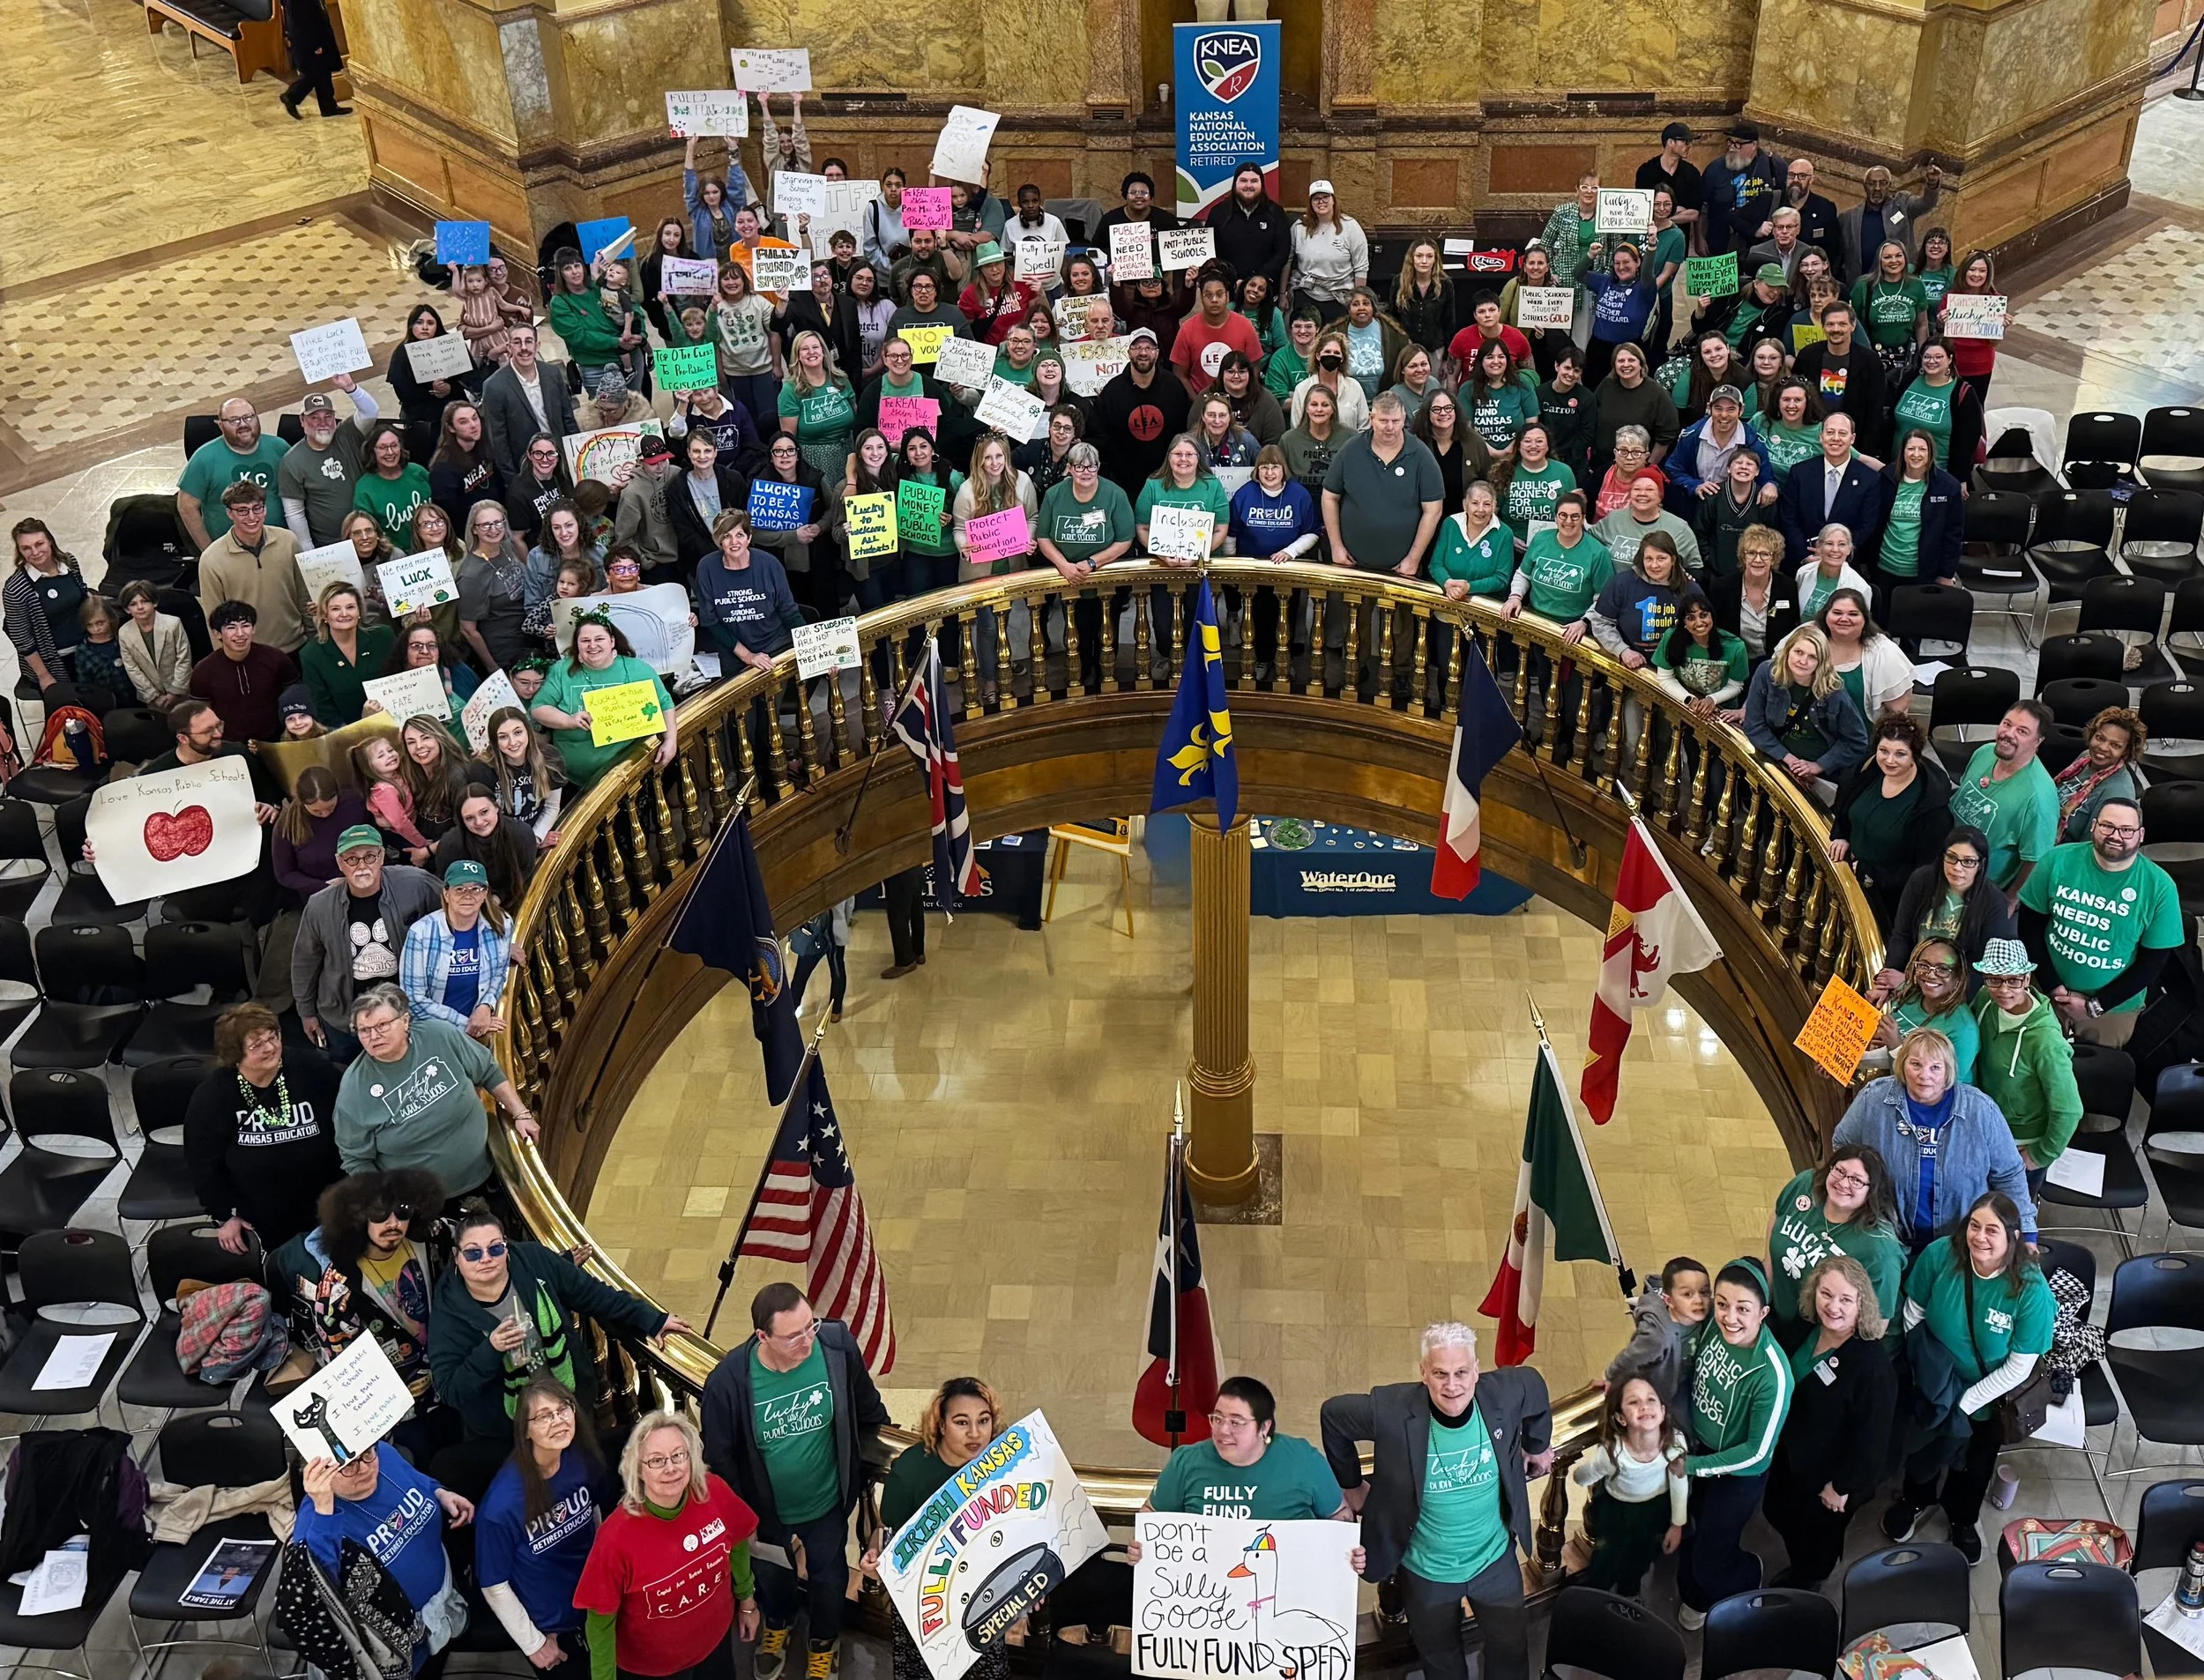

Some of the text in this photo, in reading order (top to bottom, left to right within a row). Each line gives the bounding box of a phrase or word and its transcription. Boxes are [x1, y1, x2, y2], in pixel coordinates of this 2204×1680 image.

[1201, 39, 1255, 58] KNEA
[1189, 111, 1234, 122] KANSAS
[1189, 122, 1247, 132] NATIONAL
[1189, 132, 1255, 142] EDUCATION
[1189, 143, 1264, 152] ASSOCIATION
[1190, 157, 1236, 167] RETIRED
[1113, 225, 1144, 236] PUBLIC
[1116, 244, 1143, 255] NEED
[1164, 236, 1208, 249] ANTI-PUBLIC
[756, 249, 799, 260] FULLY
[1114, 252, 1150, 263] MENTAL
[1171, 247, 1206, 259] SCHOOLS
[756, 261, 794, 273] FUND
[1024, 256, 1054, 274] Sped!
[1121, 262, 1145, 271] HEALTH
[1688, 259, 1714, 271] PUBLIC
[1715, 266, 1735, 279] EVERY
[1116, 269, 1151, 279] SERVICES
[1549, 313, 1568, 323] GOLD
[912, 331, 936, 343] NO
[1096, 362, 1122, 376] NOT
[1820, 375, 1843, 396] KC
[895, 398, 917, 409] REAL
[1474, 416, 1512, 425] KANSAS
[463, 464, 488, 490] NEA
[756, 480, 800, 499] LUCKY
[1509, 480, 1549, 490] PUBLIC
[751, 494, 798, 509] TO BE A
[904, 486, 940, 502] PUBLIC
[1509, 489, 1547, 499] MONEY
[853, 502, 884, 518] Lucky
[901, 498, 938, 515] MONEY
[1509, 498, 1530, 507] FOR
[751, 507, 800, 520] KANSAS
[909, 510, 925, 522] FOR
[1248, 505, 1292, 520] PROUD
[1509, 505, 1551, 516] PUBLIC
[900, 517, 935, 532] PUBLIC
[1155, 509, 1211, 532] Inclusion
[899, 529, 937, 544] SCHOOLS
[970, 529, 1001, 543] Public
[400, 567, 433, 586] LUCK
[727, 588, 753, 598] STRONG
[738, 593, 766, 603] SCHOOLS
[730, 608, 756, 617] STRONG
[1648, 602, 1675, 615] One job
[794, 617, 854, 639] OUR STUDENTS
[1647, 617, 1672, 628] should
[798, 627, 853, 648] ARE NOT FOR
[99, 790, 128, 805] Love
[136, 782, 172, 797] Kansas
[209, 769, 244, 783] Schools
[463, 862, 478, 873] KC
[1299, 871, 1396, 887] WaterOne
[2056, 885, 2130, 917] KANSAS
[2052, 902, 2111, 931] NEEDS
[2049, 933, 2126, 970] SCHOOLS.
[1831, 994, 1865, 1030] KANSAS
[420, 1082, 447, 1104] SCHOOLS
[238, 1133, 272, 1144] KANSAS
[274, 1124, 318, 1142] EDUCATOR
[1710, 1334, 1742, 1379] UBLIC
[323, 1379, 332, 1389] I
[333, 1368, 348, 1381] love
[332, 1395, 358, 1418] I love
[764, 1393, 812, 1422] lucky
[353, 1412, 379, 1436] I love
[763, 1413, 823, 1441] PUBLIC SCHOOLS
[892, 1431, 1024, 1570] IRISH KANSAS
[1203, 1485, 1257, 1501] FULLY
[525, 1486, 590, 1542] PROUD
[1203, 1505, 1251, 1519] FUND
[366, 1488, 424, 1554] PROUD
[532, 1505, 592, 1551] RETIRED EDUCATOR
[380, 1503, 435, 1563] RETIRED EDUCATOR
[922, 1482, 1047, 1636] FULLY FUNDED
[1155, 1541, 1209, 1564] be a
[1150, 1566, 1232, 1612] Silly
[186, 1595, 208, 1605] TABLE
[208, 1597, 223, 1606] THE
[659, 1582, 710, 1613] C. A. R.
[978, 1572, 1049, 1645] SPECIAL ED
[1143, 1599, 1247, 1631] Goose
[1137, 1633, 1348, 1680] FULLY FUND SPED
